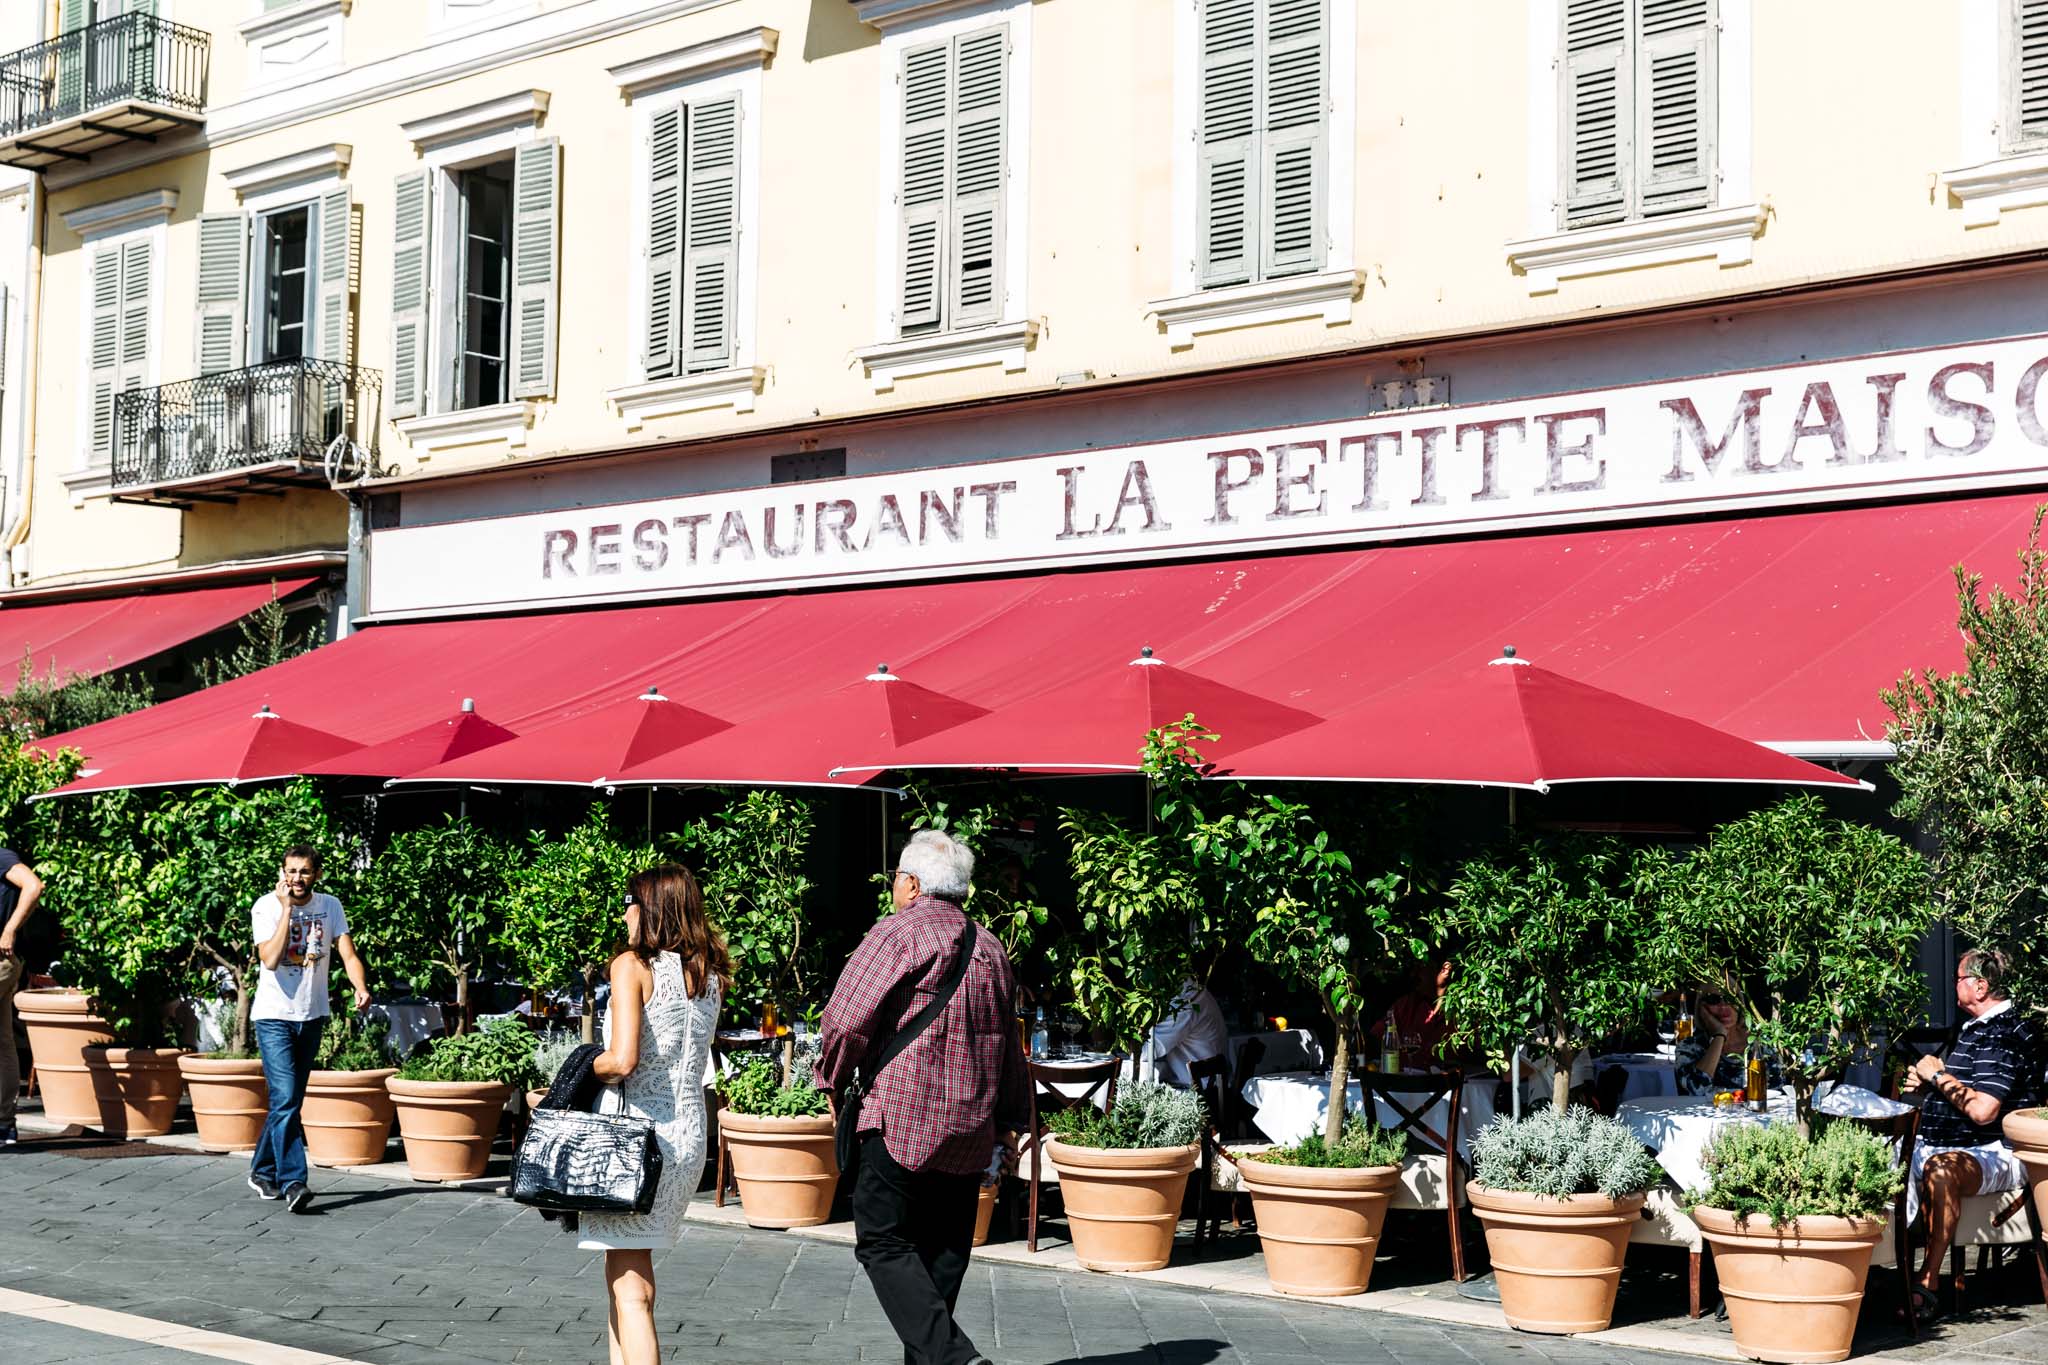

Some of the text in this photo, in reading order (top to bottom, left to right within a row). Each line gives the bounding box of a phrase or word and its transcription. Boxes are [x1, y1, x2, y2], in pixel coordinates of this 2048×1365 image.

[542, 481, 1017, 580] RESTAURANT
[1055, 460, 1173, 541] LA
[1203, 407, 1607, 525] PETITE
